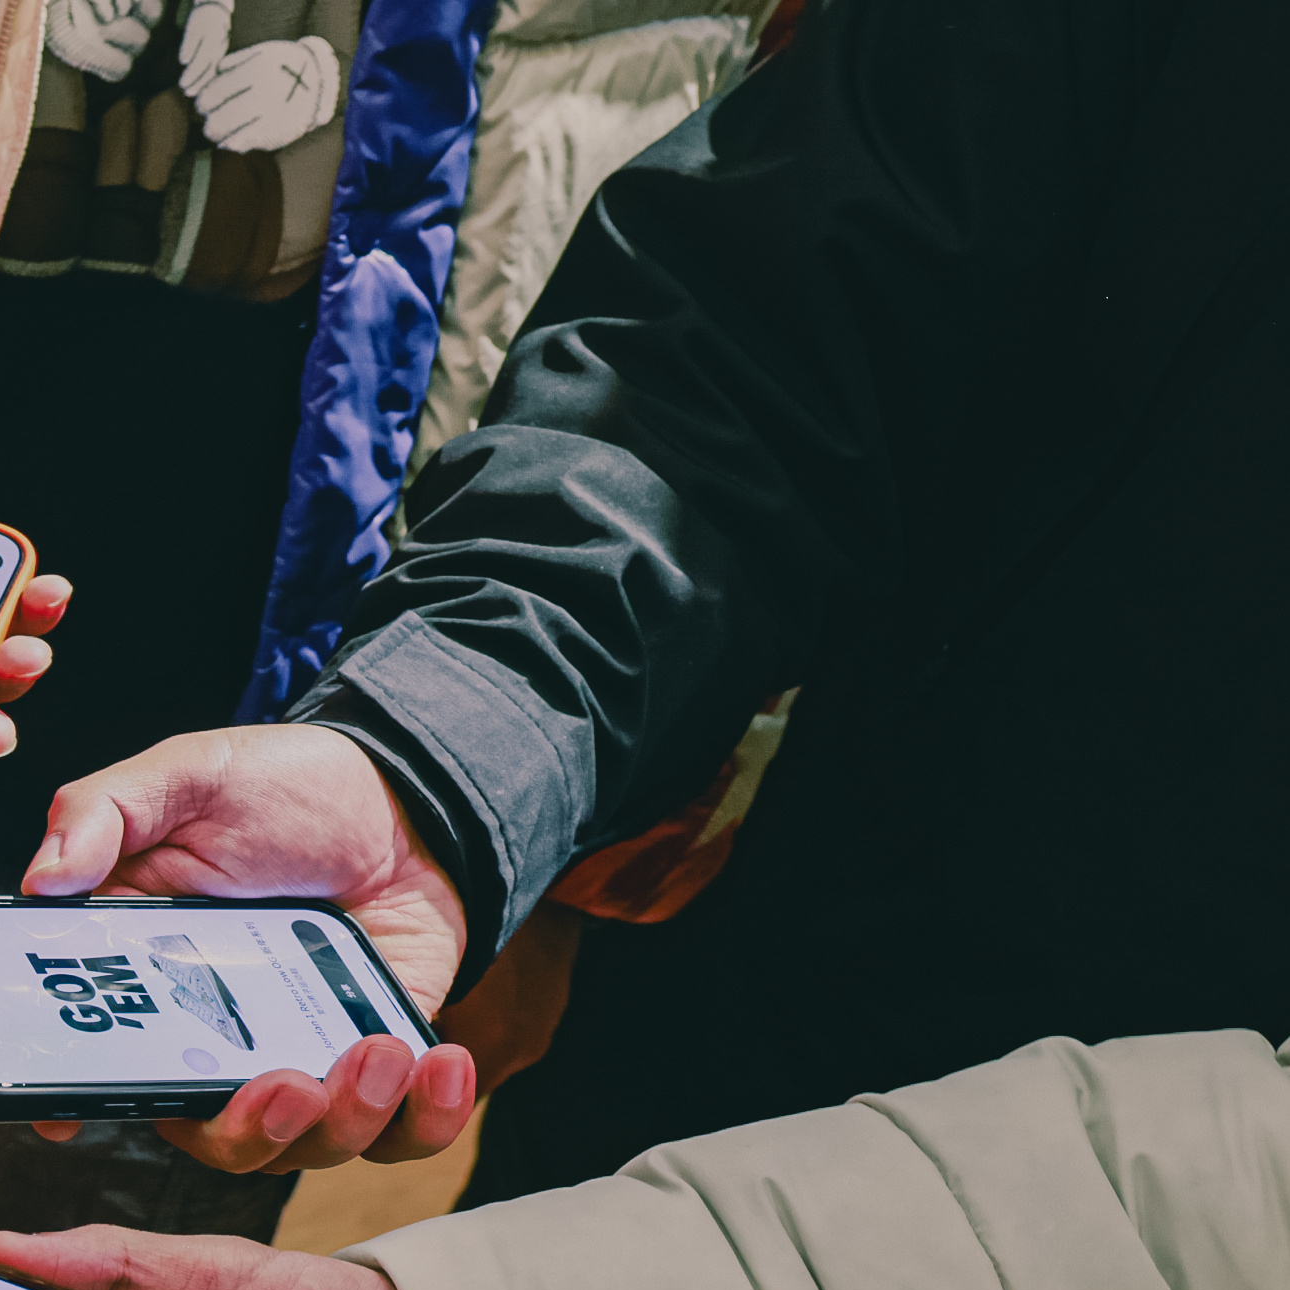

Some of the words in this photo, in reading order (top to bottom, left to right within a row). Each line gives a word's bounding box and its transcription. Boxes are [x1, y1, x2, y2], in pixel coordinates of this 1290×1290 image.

[275, 970, 295, 987] Low
[338, 983, 358, 998] 分享
[23, 952, 119, 1034] GOT
[79, 954, 169, 1030] 'EM
[287, 989, 311, 1011] Retro
[307, 1020, 335, 1050] Jordan
